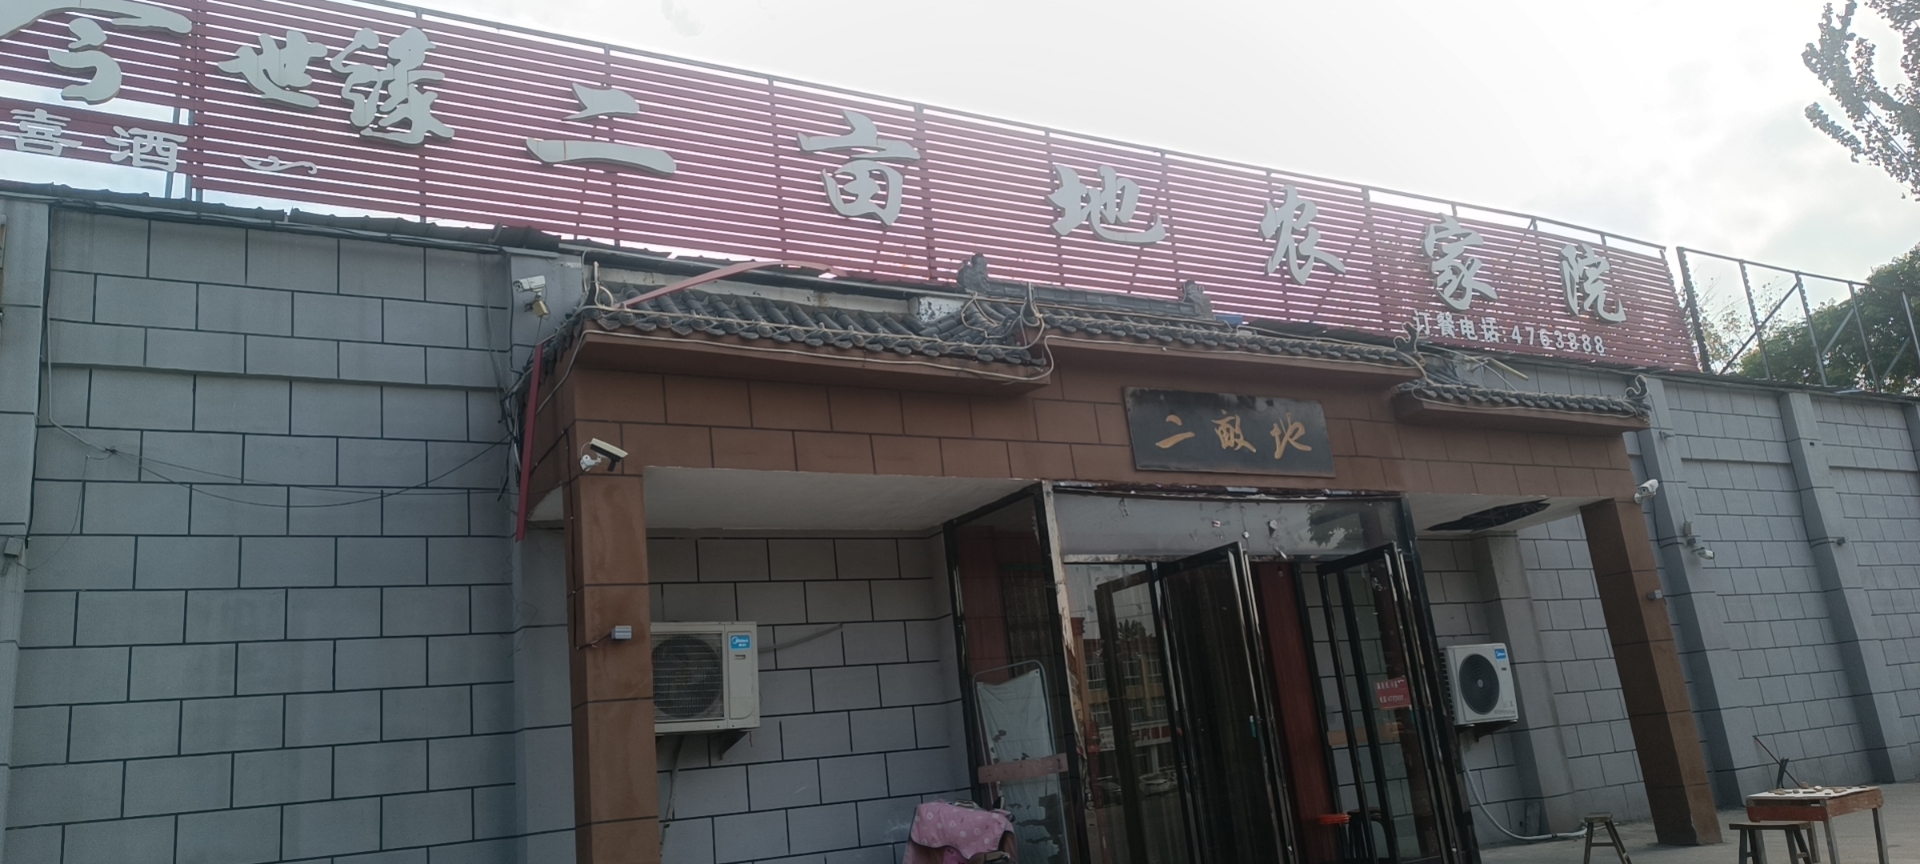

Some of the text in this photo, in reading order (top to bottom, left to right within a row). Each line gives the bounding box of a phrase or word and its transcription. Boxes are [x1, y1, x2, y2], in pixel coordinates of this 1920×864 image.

[0, 108, 187, 172] 喜酒
[526, 80, 1627, 324] 二亩地农家院
